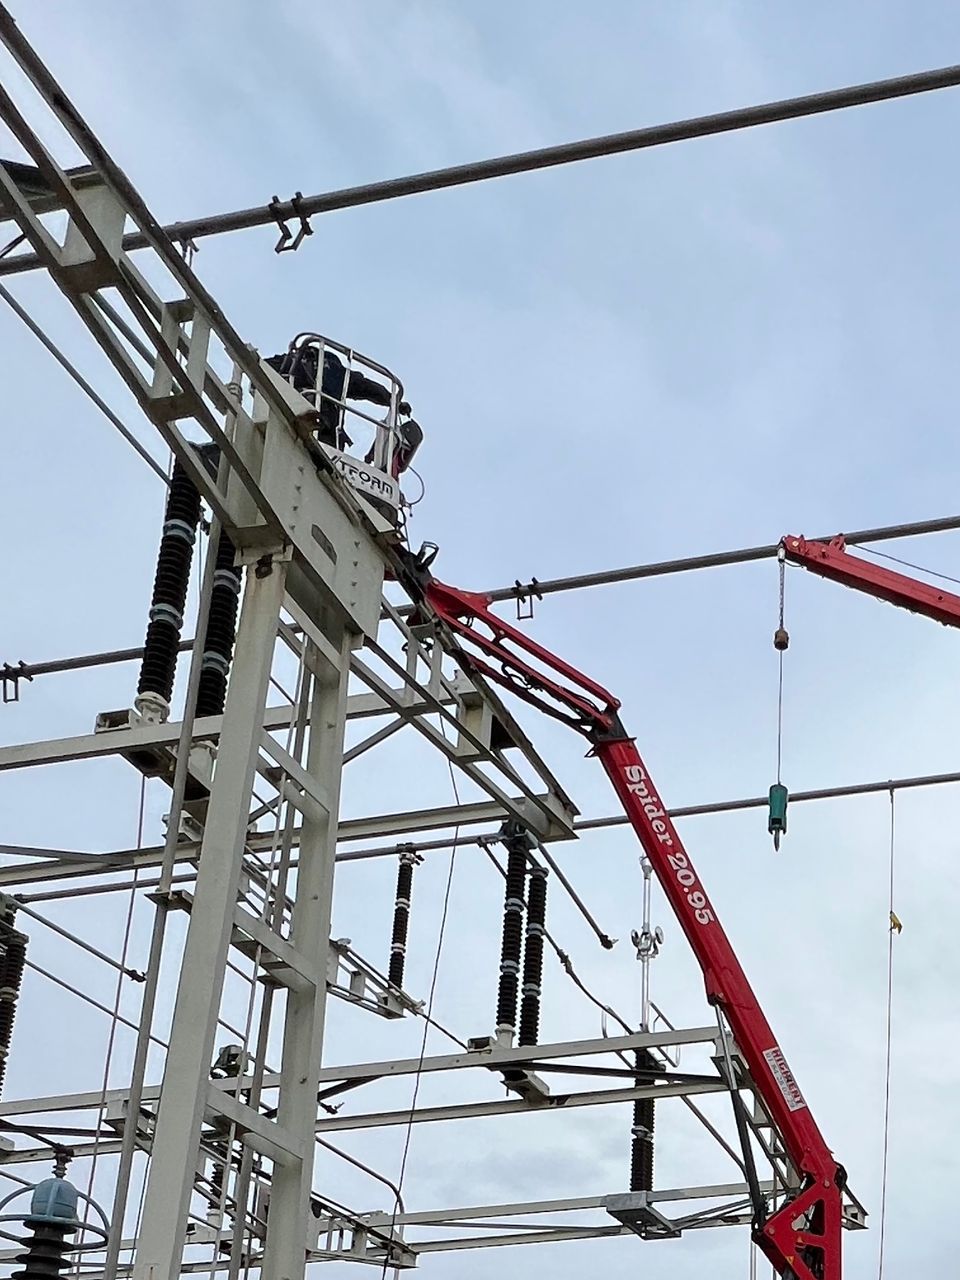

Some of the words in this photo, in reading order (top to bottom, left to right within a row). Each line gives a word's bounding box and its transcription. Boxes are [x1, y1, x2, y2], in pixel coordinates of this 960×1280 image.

[331, 455, 393, 498] TFORM
[624, 765, 673, 846] Spider
[667, 852, 714, 925] 20.95
